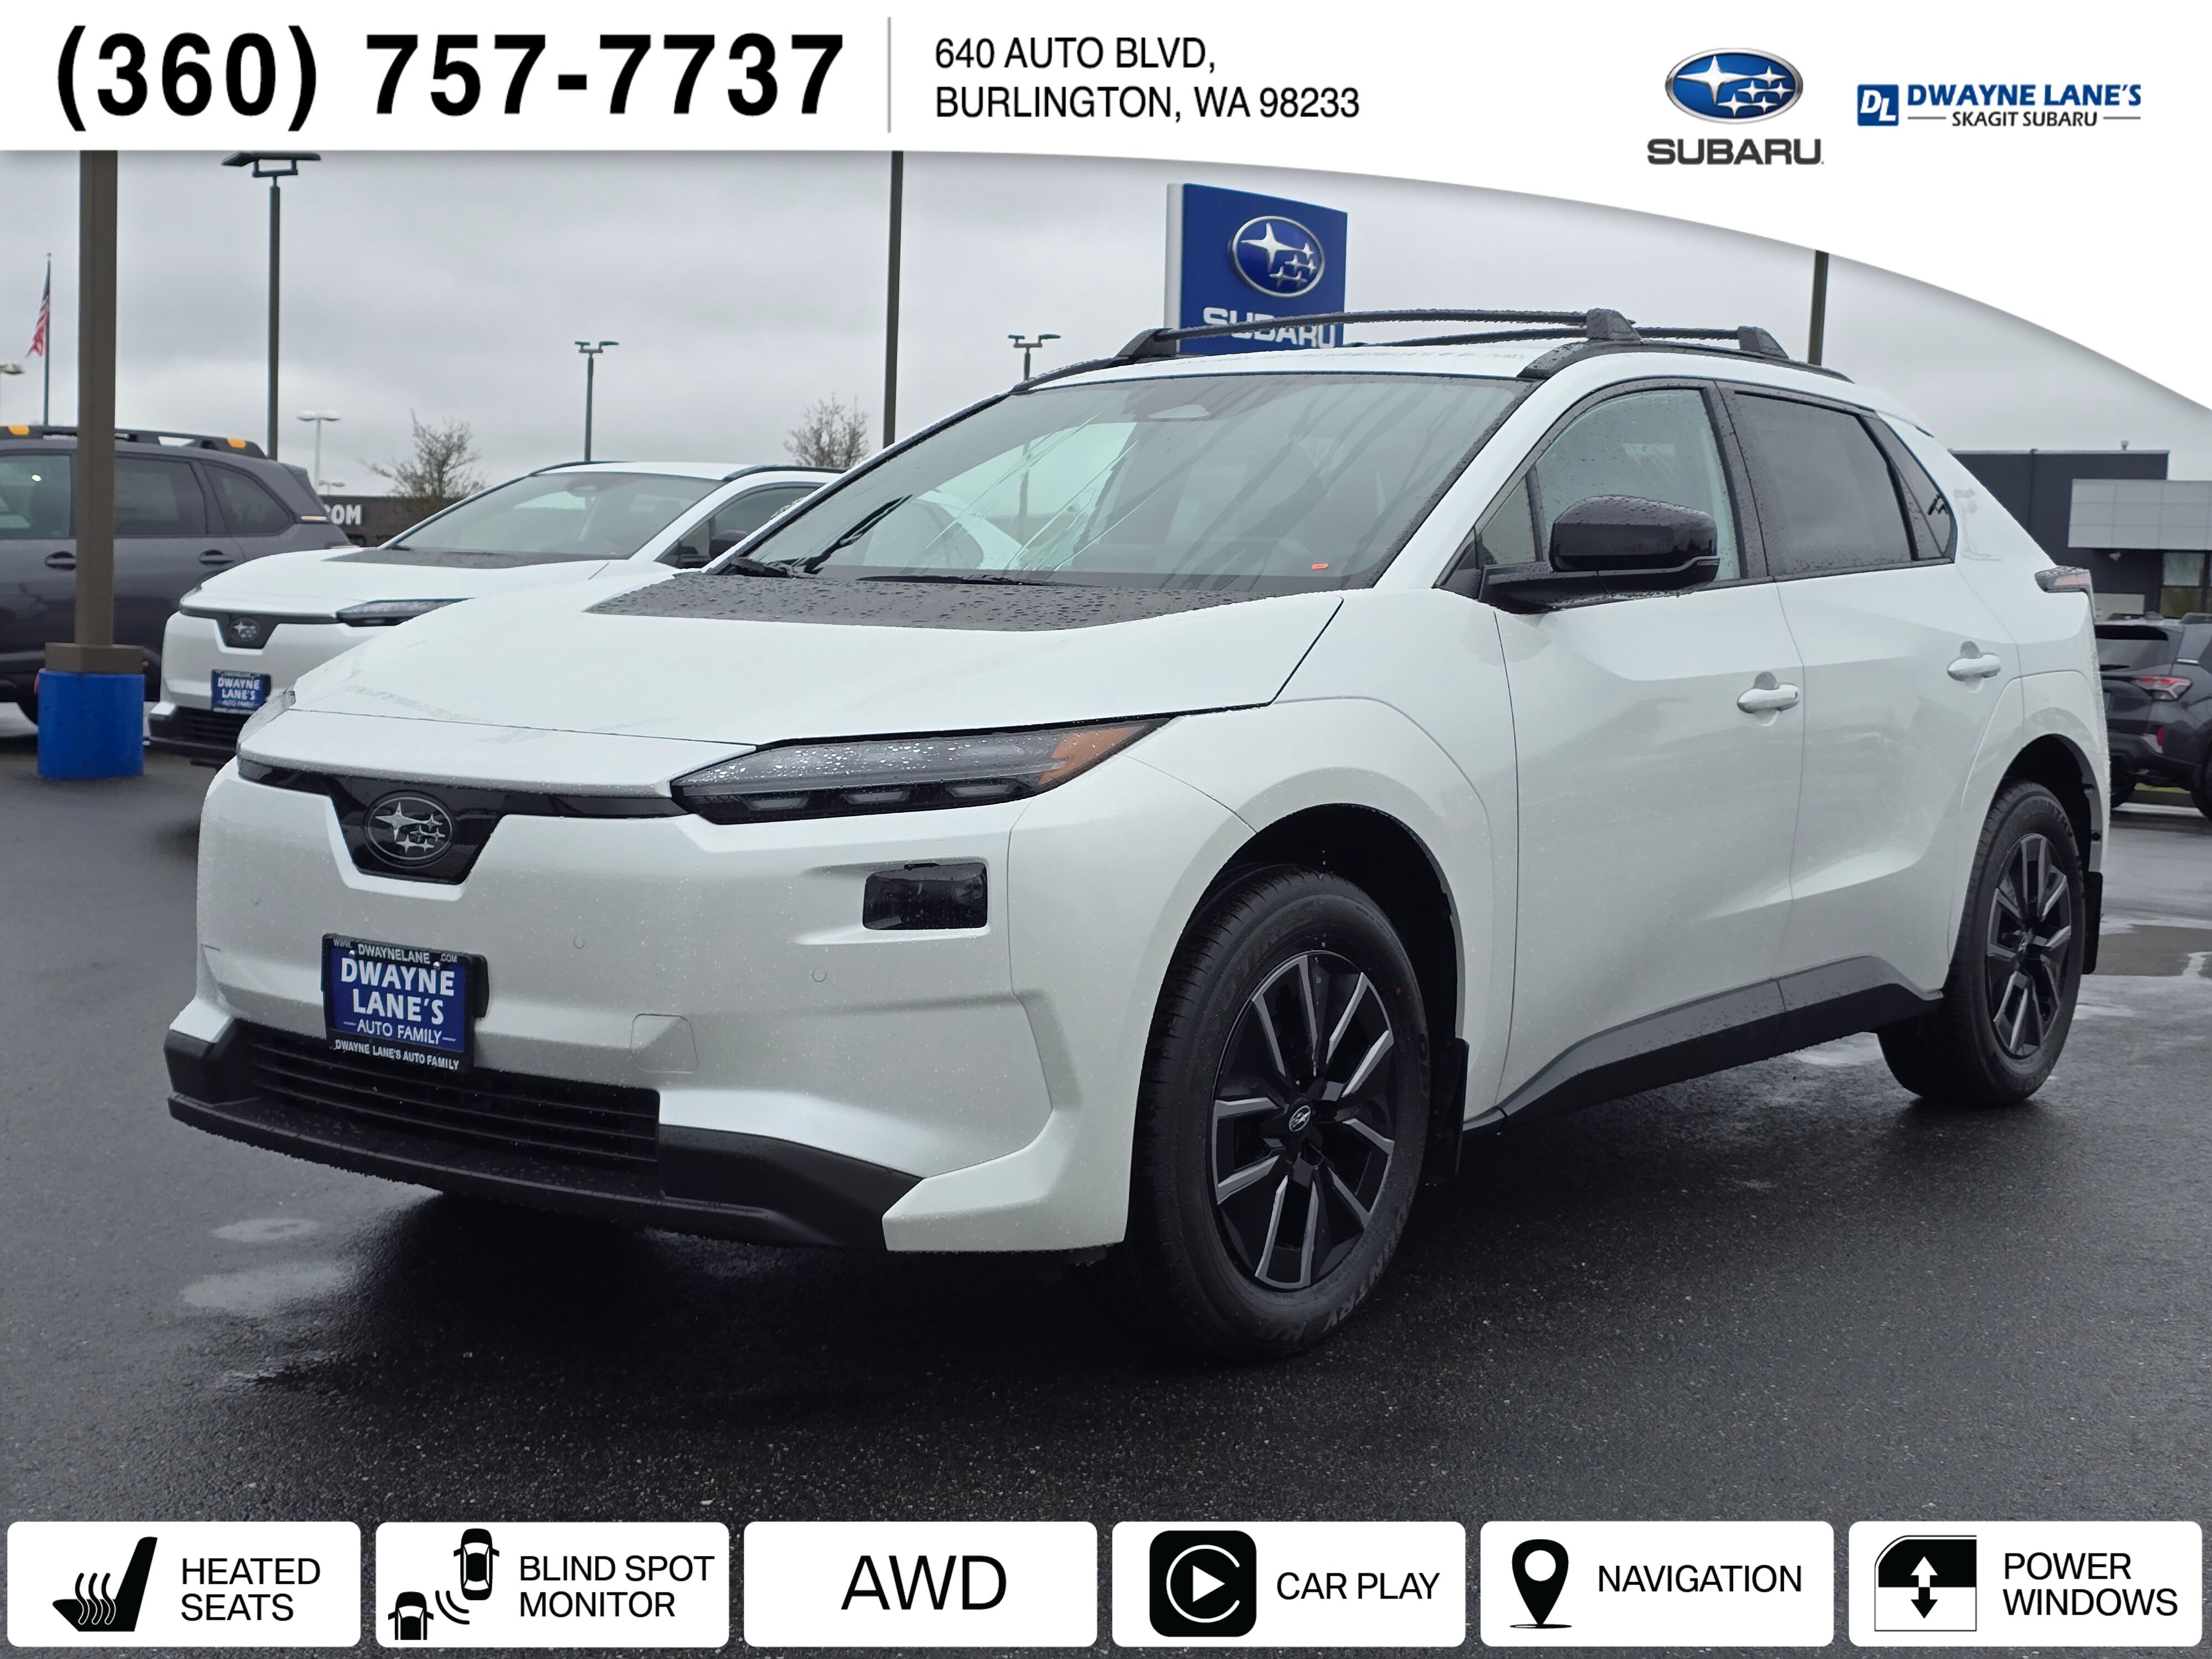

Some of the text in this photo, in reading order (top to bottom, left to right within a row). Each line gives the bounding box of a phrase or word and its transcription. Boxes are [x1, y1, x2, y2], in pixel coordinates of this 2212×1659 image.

[217, 677, 260, 690] DWAYNE
[222, 688, 255, 701] LANE'S
[358, 943, 431, 964] DWAYNELANE
[341, 958, 455, 996] DWAYNE
[353, 989, 444, 1025] LANE'S
[357, 1019, 442, 1045] AUTO FAMILY
[335, 1039, 460, 1070] DWAYNE LANE'S AUTO FAMILY
